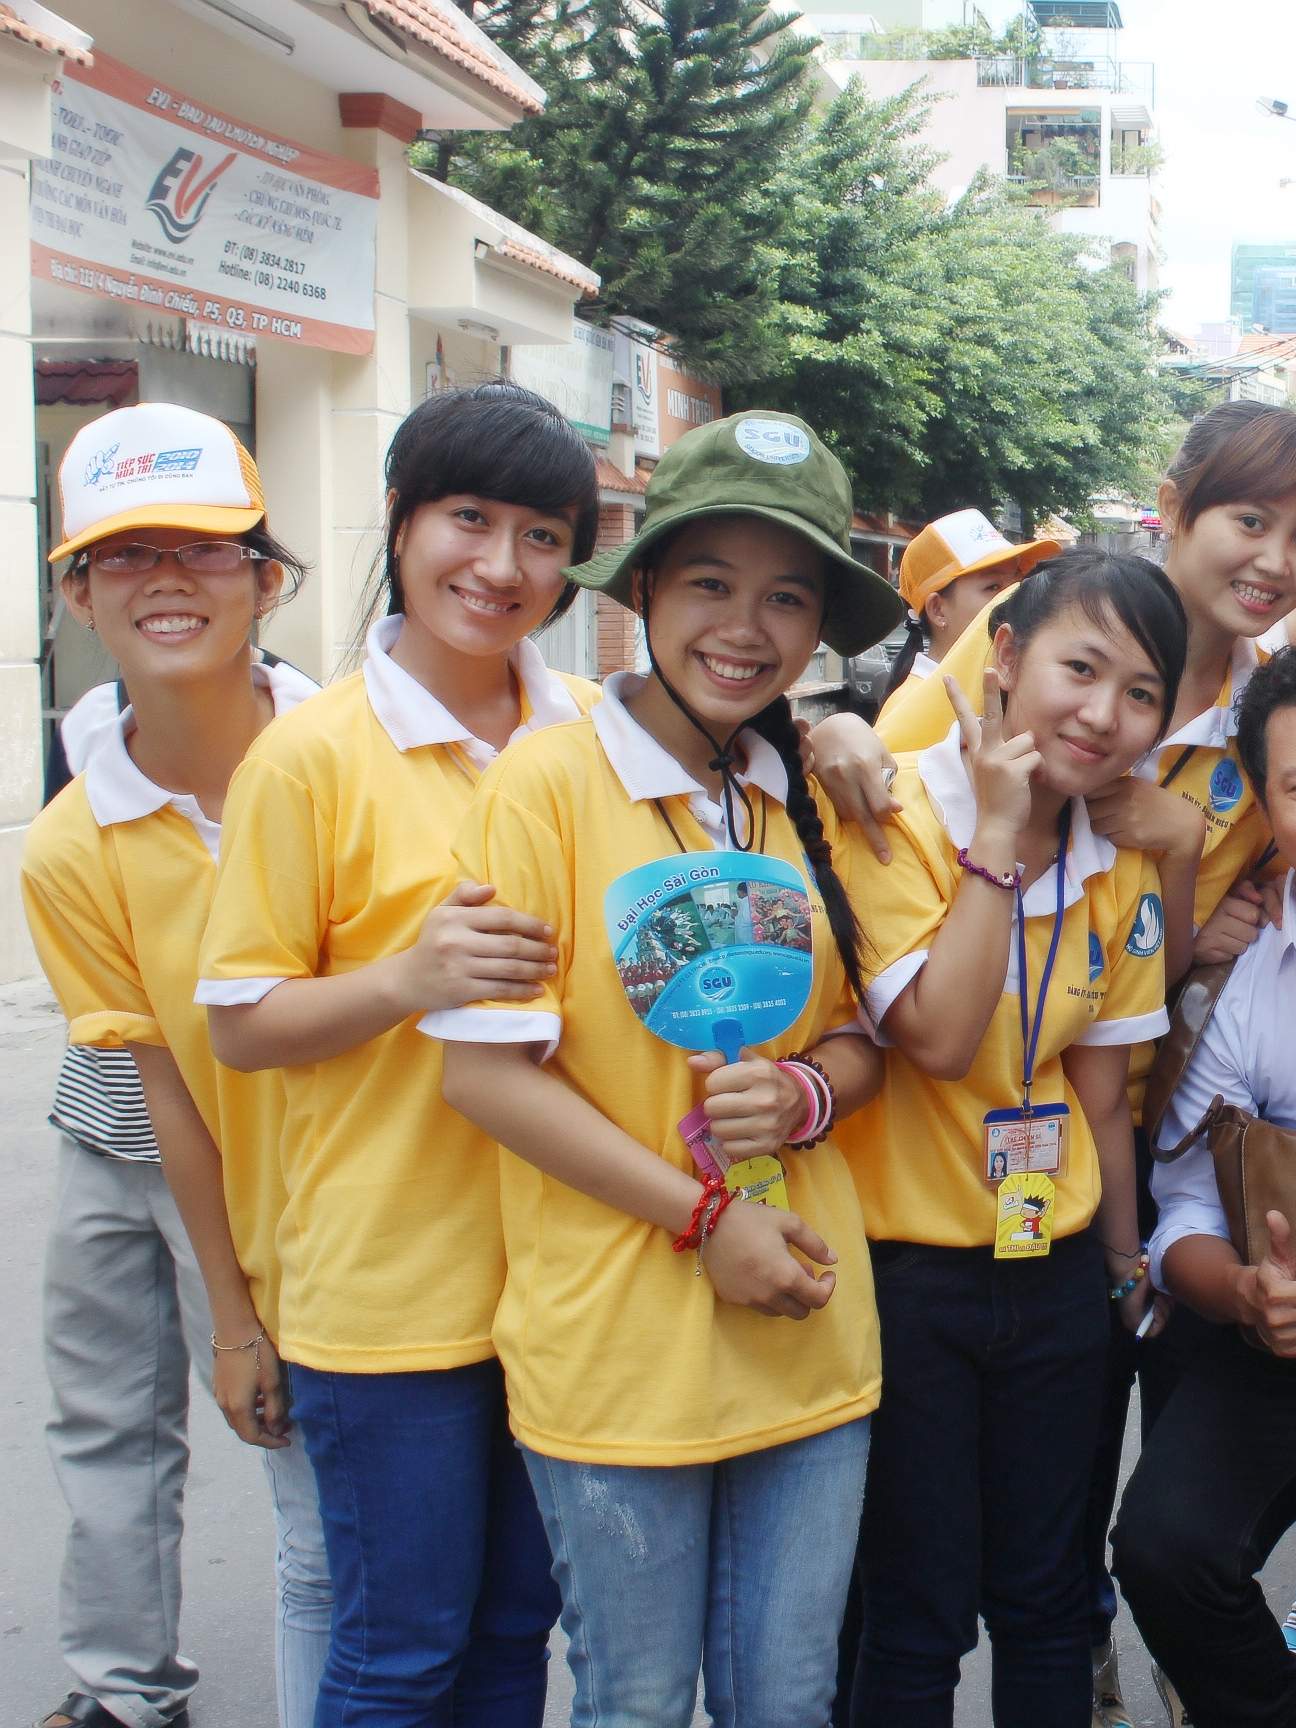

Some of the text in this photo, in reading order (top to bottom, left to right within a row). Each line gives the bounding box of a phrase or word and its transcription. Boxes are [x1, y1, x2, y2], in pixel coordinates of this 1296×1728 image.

[254, 270, 274, 290] (08)
[277, 276, 300, 294] 2240
[302, 283, 327, 300] 6368
[202, 300, 222, 322] P5,
[225, 306, 247, 329] Q3,
[251, 311, 269, 332] TP
[271, 318, 301, 338] HCM
[744, 428, 800, 448] SGU
[137, 464, 152, 475] THI
[617, 866, 720, 931] Đại Học Sài Gòn
[703, 976, 732, 990] SGU
